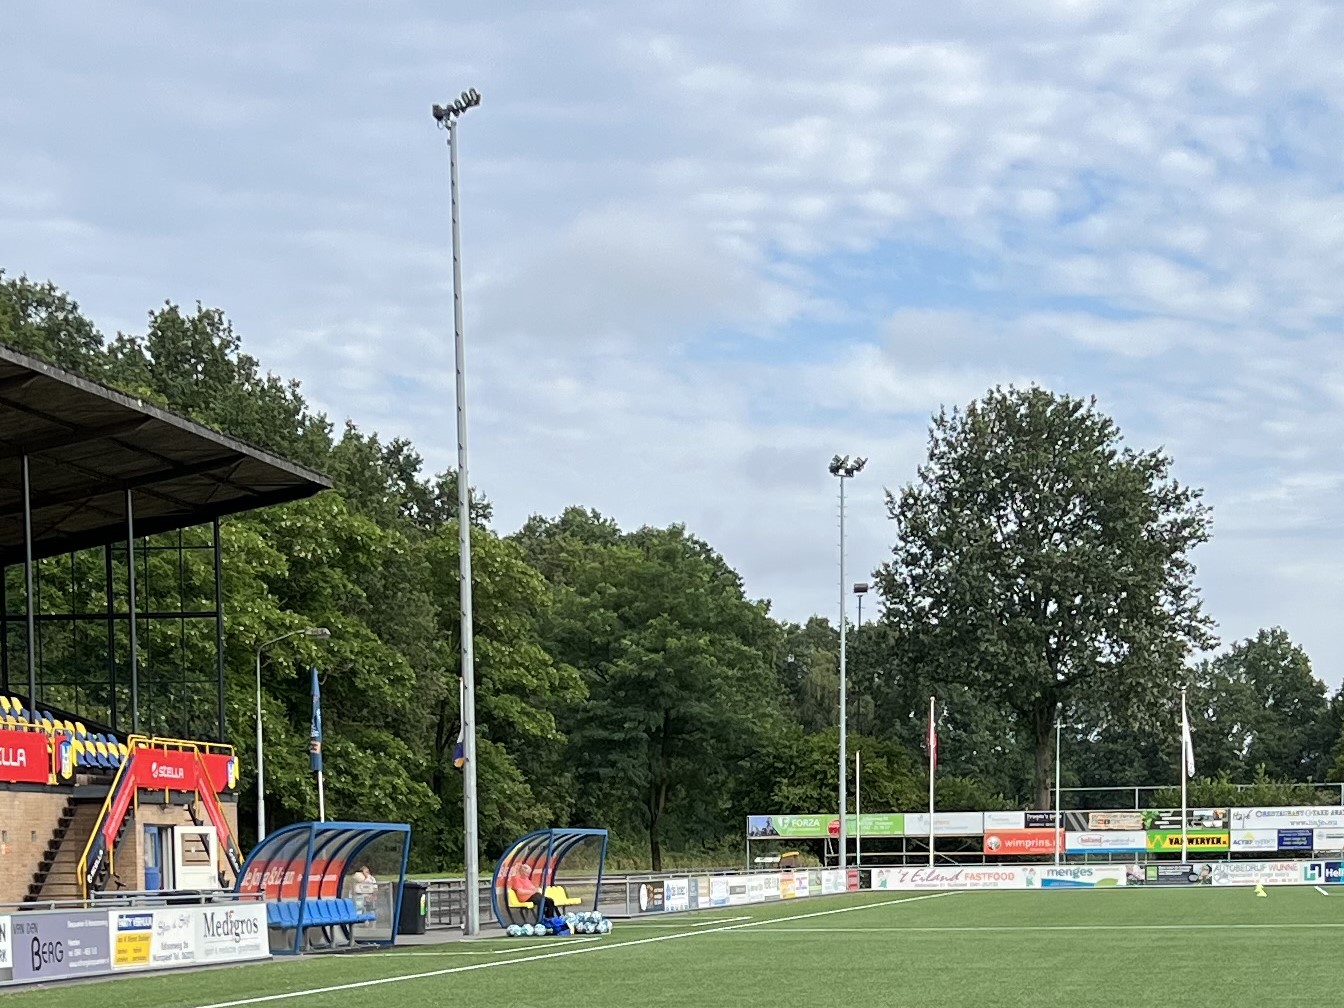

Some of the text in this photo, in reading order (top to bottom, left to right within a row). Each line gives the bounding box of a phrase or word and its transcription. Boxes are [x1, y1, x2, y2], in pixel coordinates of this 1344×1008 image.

[791, 818, 821, 828] FORZA
[911, 869, 964, 883] Eiland
[964, 872, 1015, 881] FASTFOOD
[1047, 866, 1093, 878] menges
[203, 911, 259, 943] Medigros
